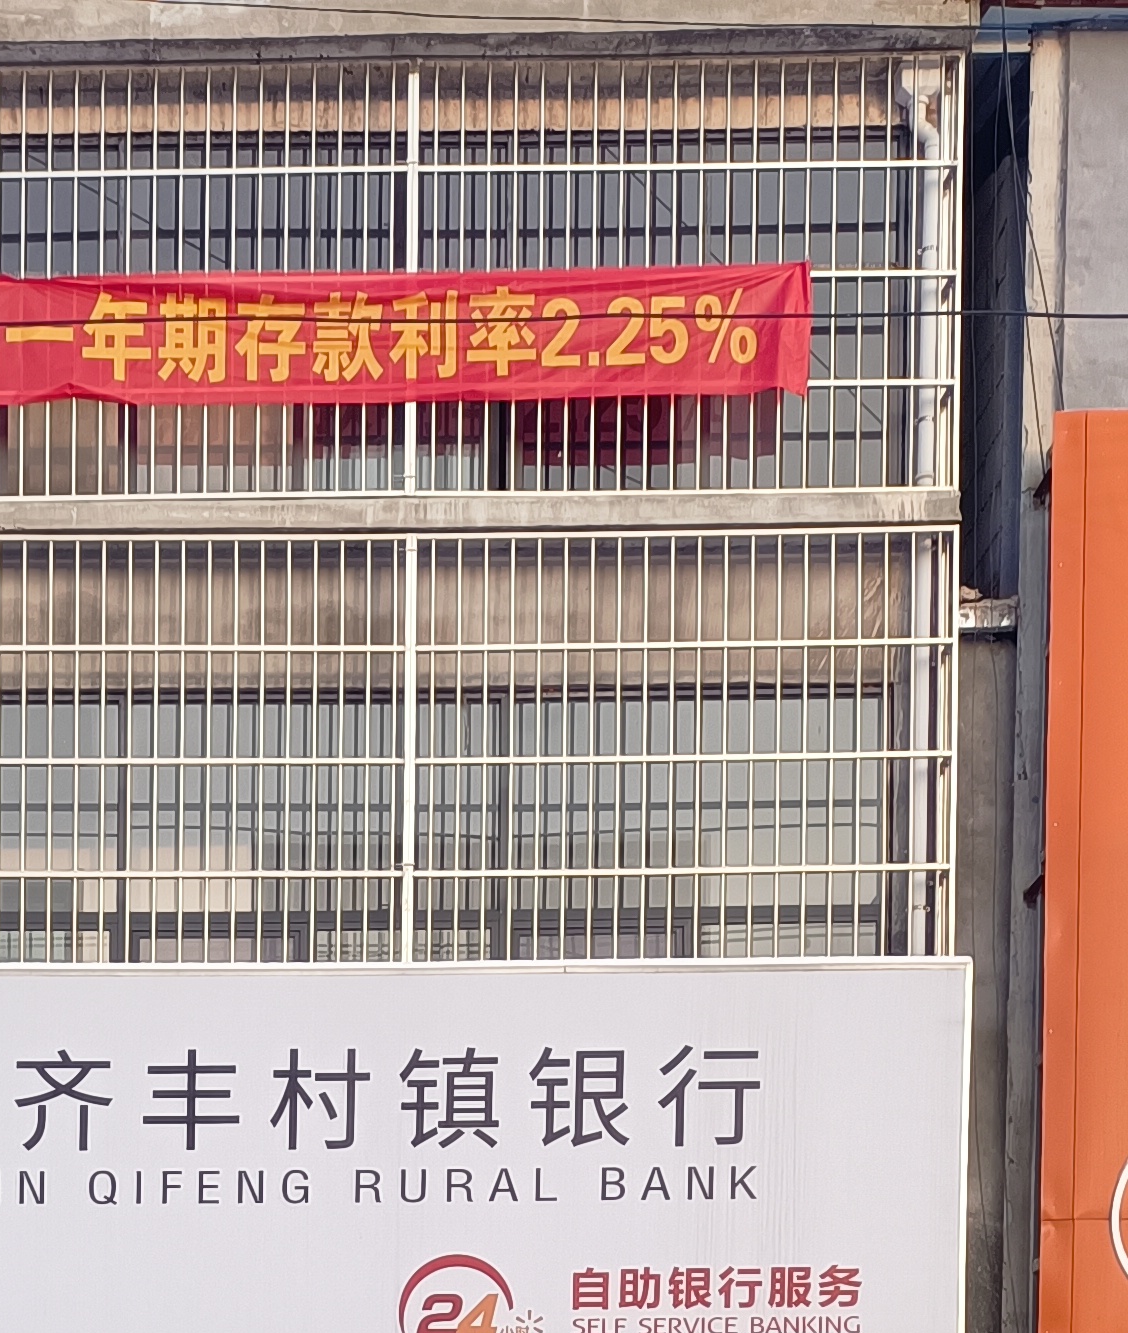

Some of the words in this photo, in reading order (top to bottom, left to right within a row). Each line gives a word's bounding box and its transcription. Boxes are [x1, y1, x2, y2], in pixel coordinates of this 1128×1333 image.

[6, 286, 757, 383] 一年期存款利率2.25%
[88, 1169, 310, 1205] QIFENG
[354, 1168, 558, 1203] RURAL
[600, 1166, 758, 1201] BANK
[571, 1264, 862, 1310] 自助银行服务
